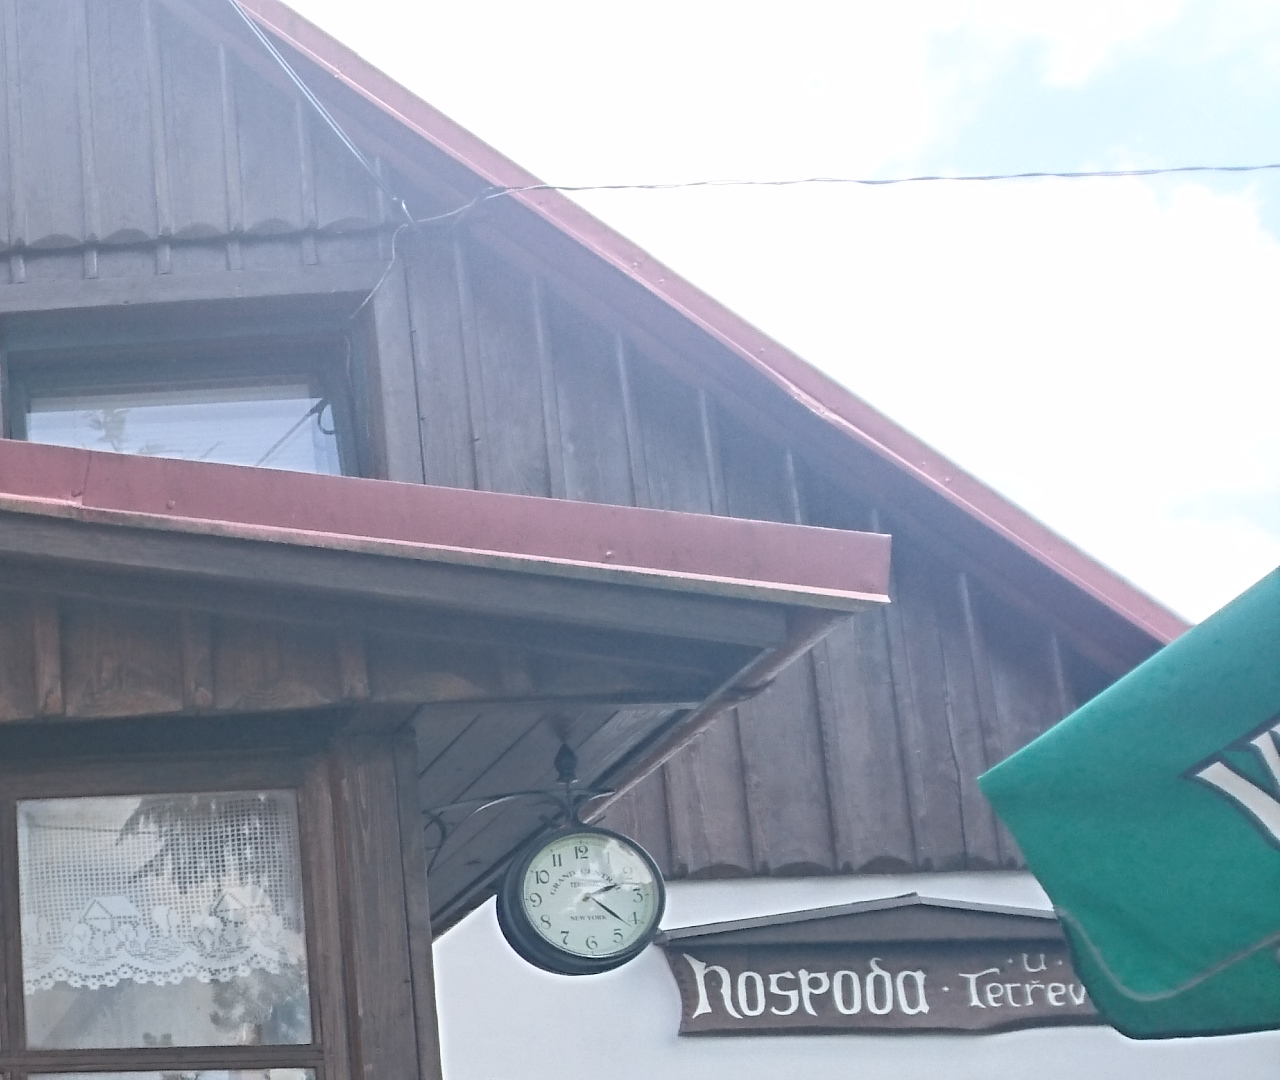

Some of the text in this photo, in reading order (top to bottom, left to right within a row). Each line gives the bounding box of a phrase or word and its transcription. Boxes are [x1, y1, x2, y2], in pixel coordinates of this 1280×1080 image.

[552, 853, 563, 867] 11
[574, 845, 589, 860] 12
[535, 869, 550, 885] 10
[622, 866, 633, 880] 2
[550, 870, 576, 896] GRAND
[529, 892, 543, 908] 9
[632, 888, 643, 903] 3
[540, 914, 552, 930] 8
[627, 911, 639, 925] 4
[560, 930, 570, 945] 7
[585, 935, 598, 950] 6
[613, 928, 624, 943] 5
[959, 967, 1086, 1009] Tetřev
